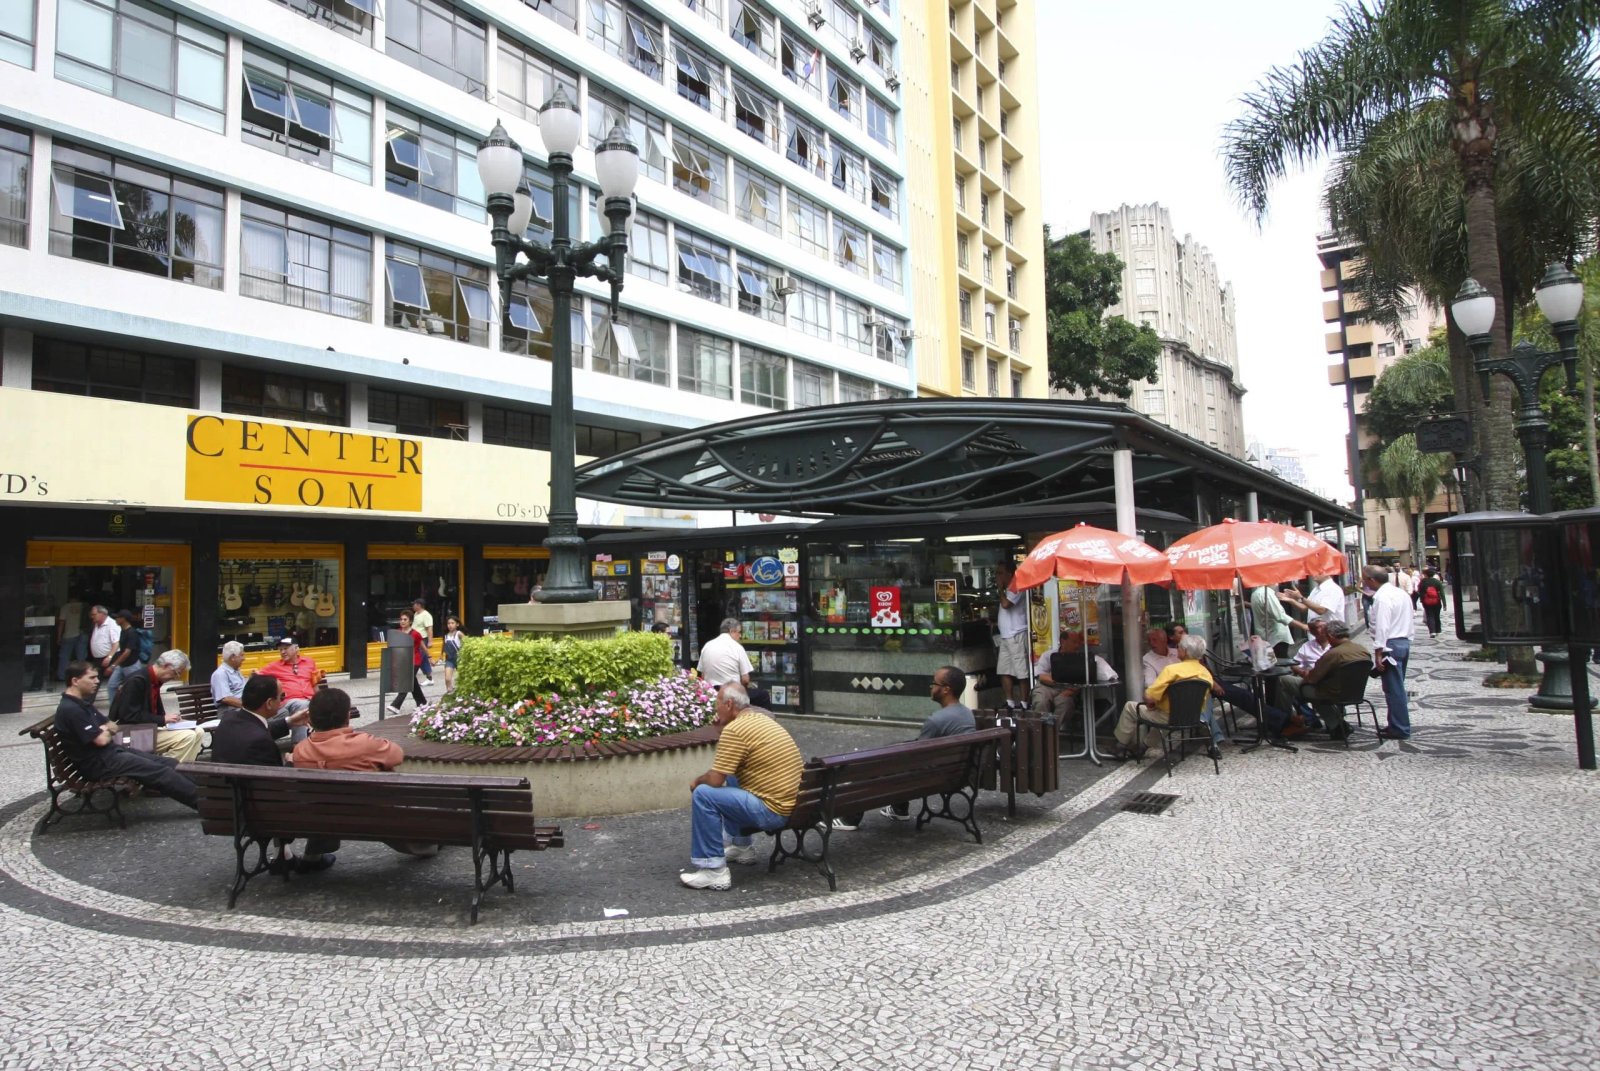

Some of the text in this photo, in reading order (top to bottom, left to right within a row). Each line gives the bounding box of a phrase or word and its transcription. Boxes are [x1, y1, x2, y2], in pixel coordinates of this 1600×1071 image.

[186, 415, 422, 475] CENTER
[0, 473, 49, 496] D's
[254, 474, 374, 510] SOM
[1188, 543, 1229, 559] matte
